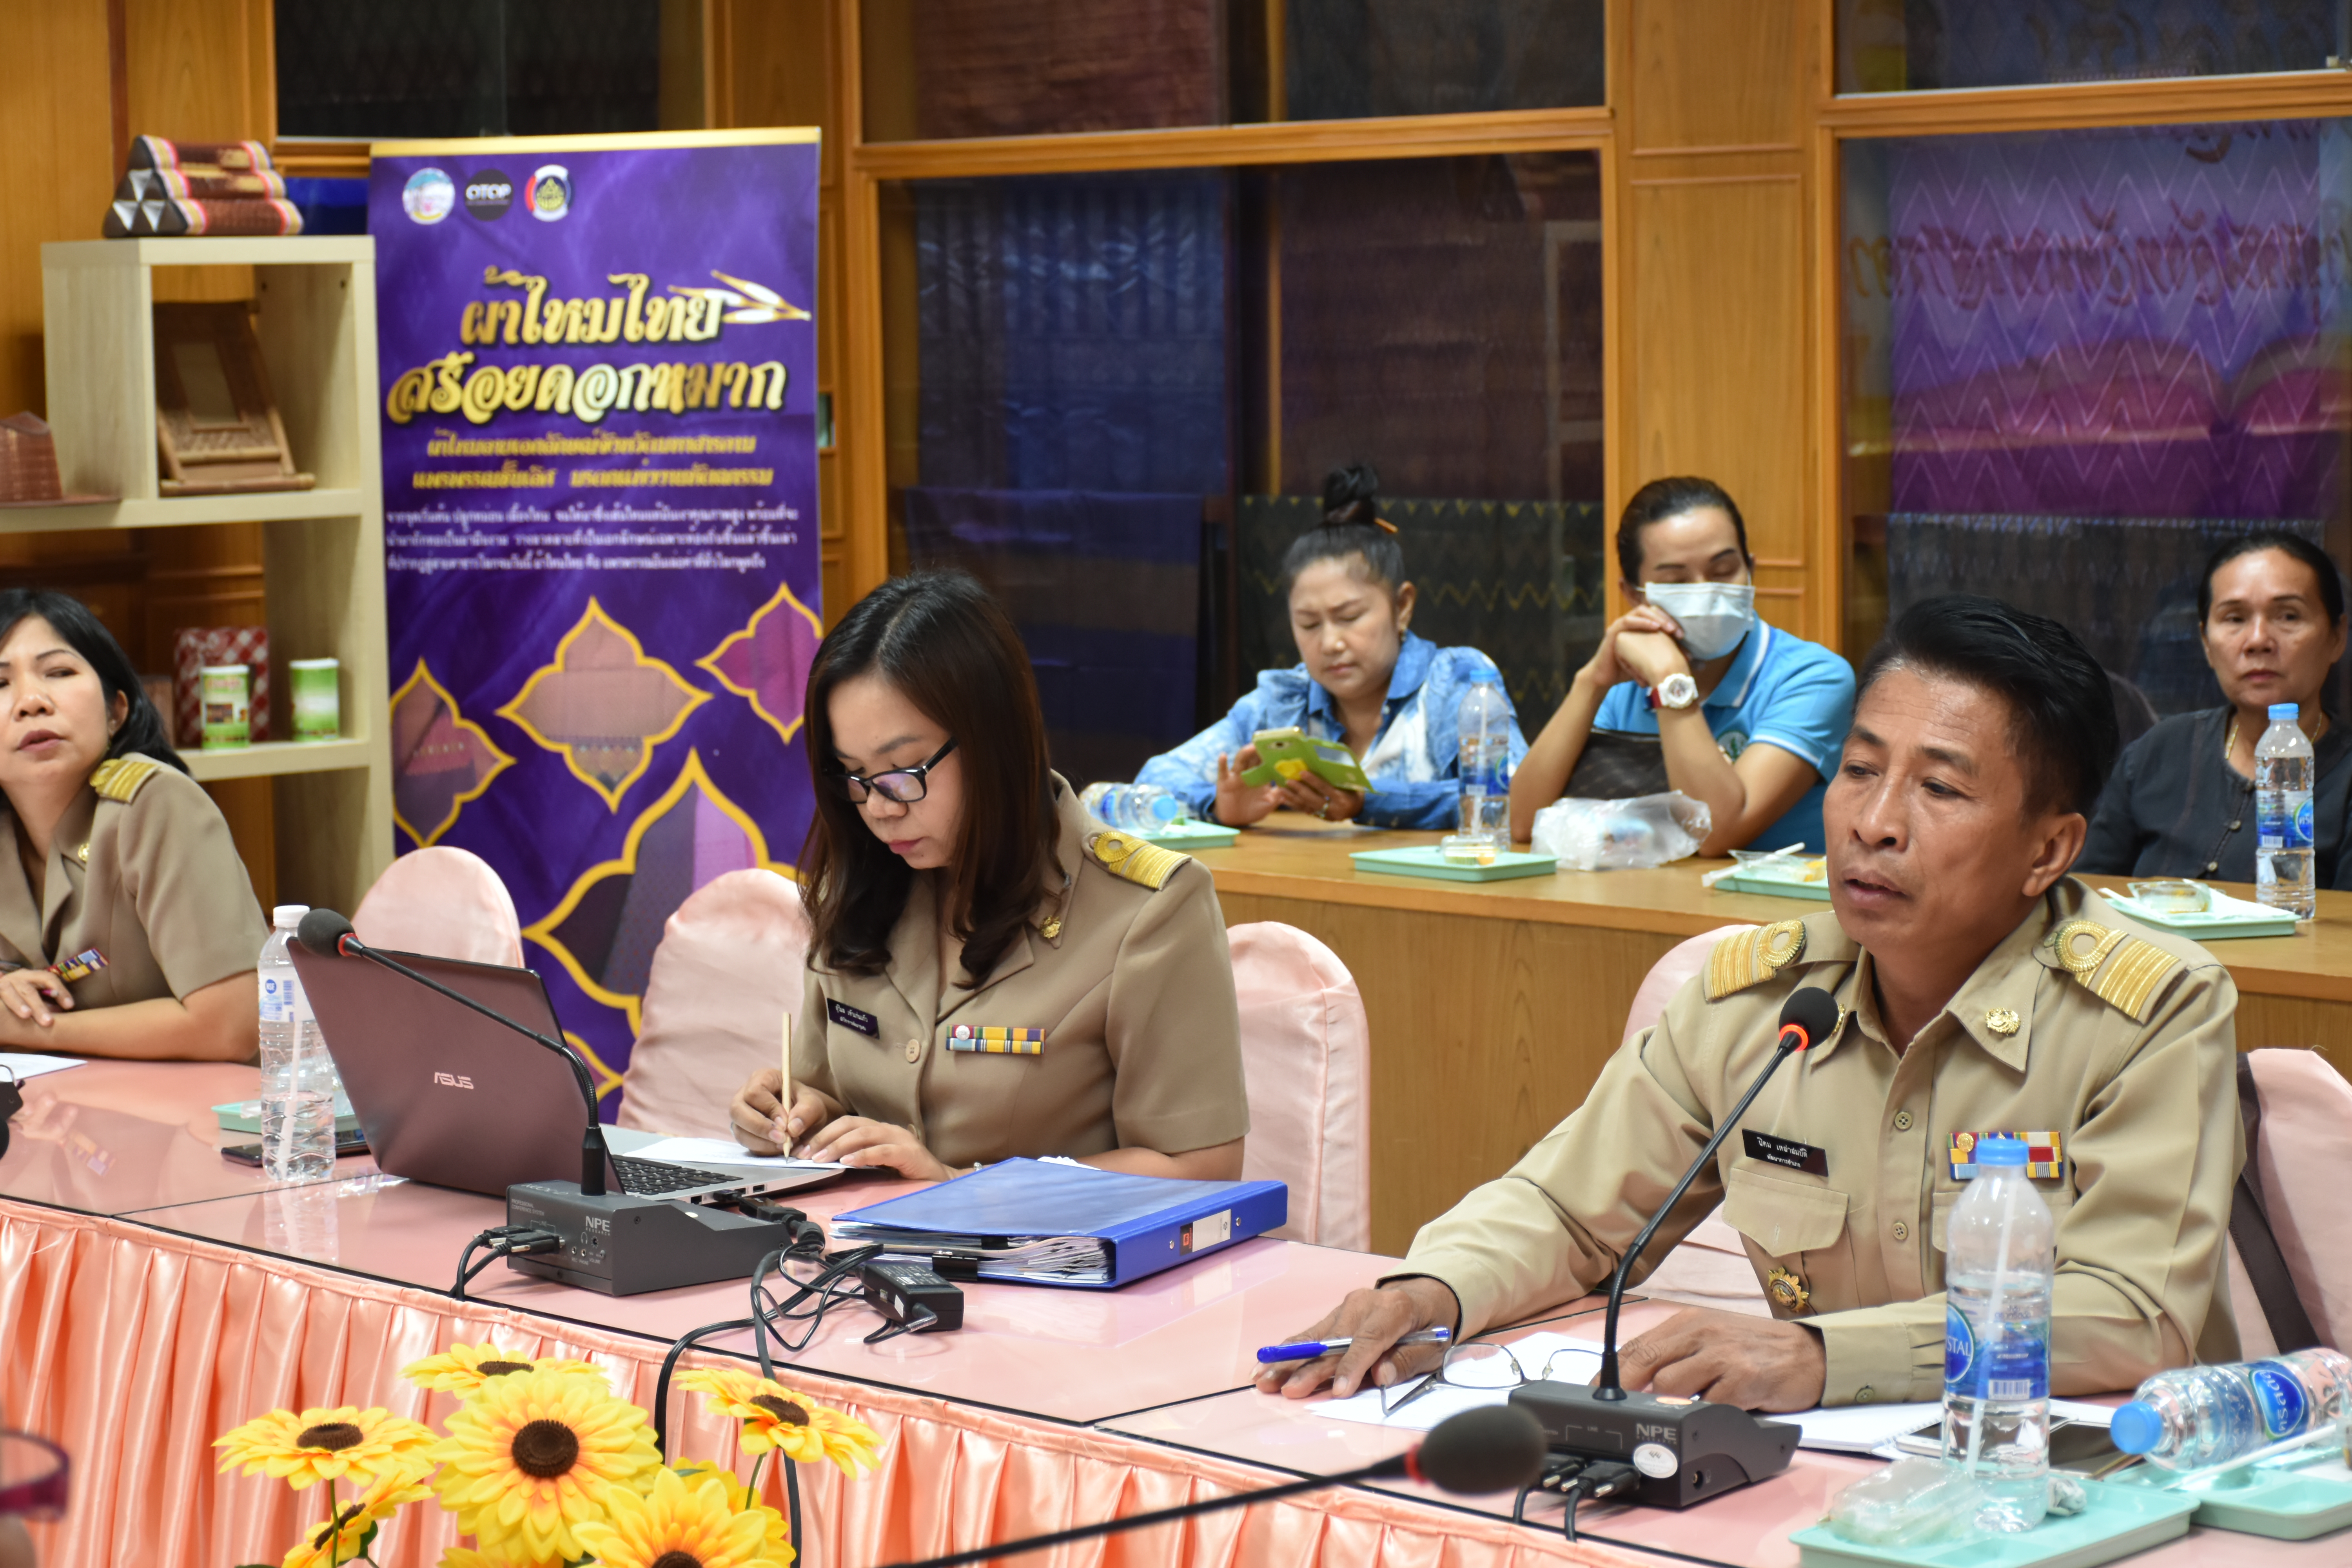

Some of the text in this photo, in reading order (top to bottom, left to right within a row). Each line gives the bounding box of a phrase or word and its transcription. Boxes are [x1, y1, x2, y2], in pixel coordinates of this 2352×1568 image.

[465, 183, 512, 201] OTOP
[461, 265, 726, 344] ผ้าไหมไทย
[387, 351, 785, 423] สร้อยดอกหมาก
[434, 1072, 474, 1089] ASUS
[586, 1216, 610, 1232] NPE
[586, 1227, 610, 1236] RESEARCH
[1947, 1335, 1971, 1356] STAL
[1636, 1423, 1677, 1441] NPE
